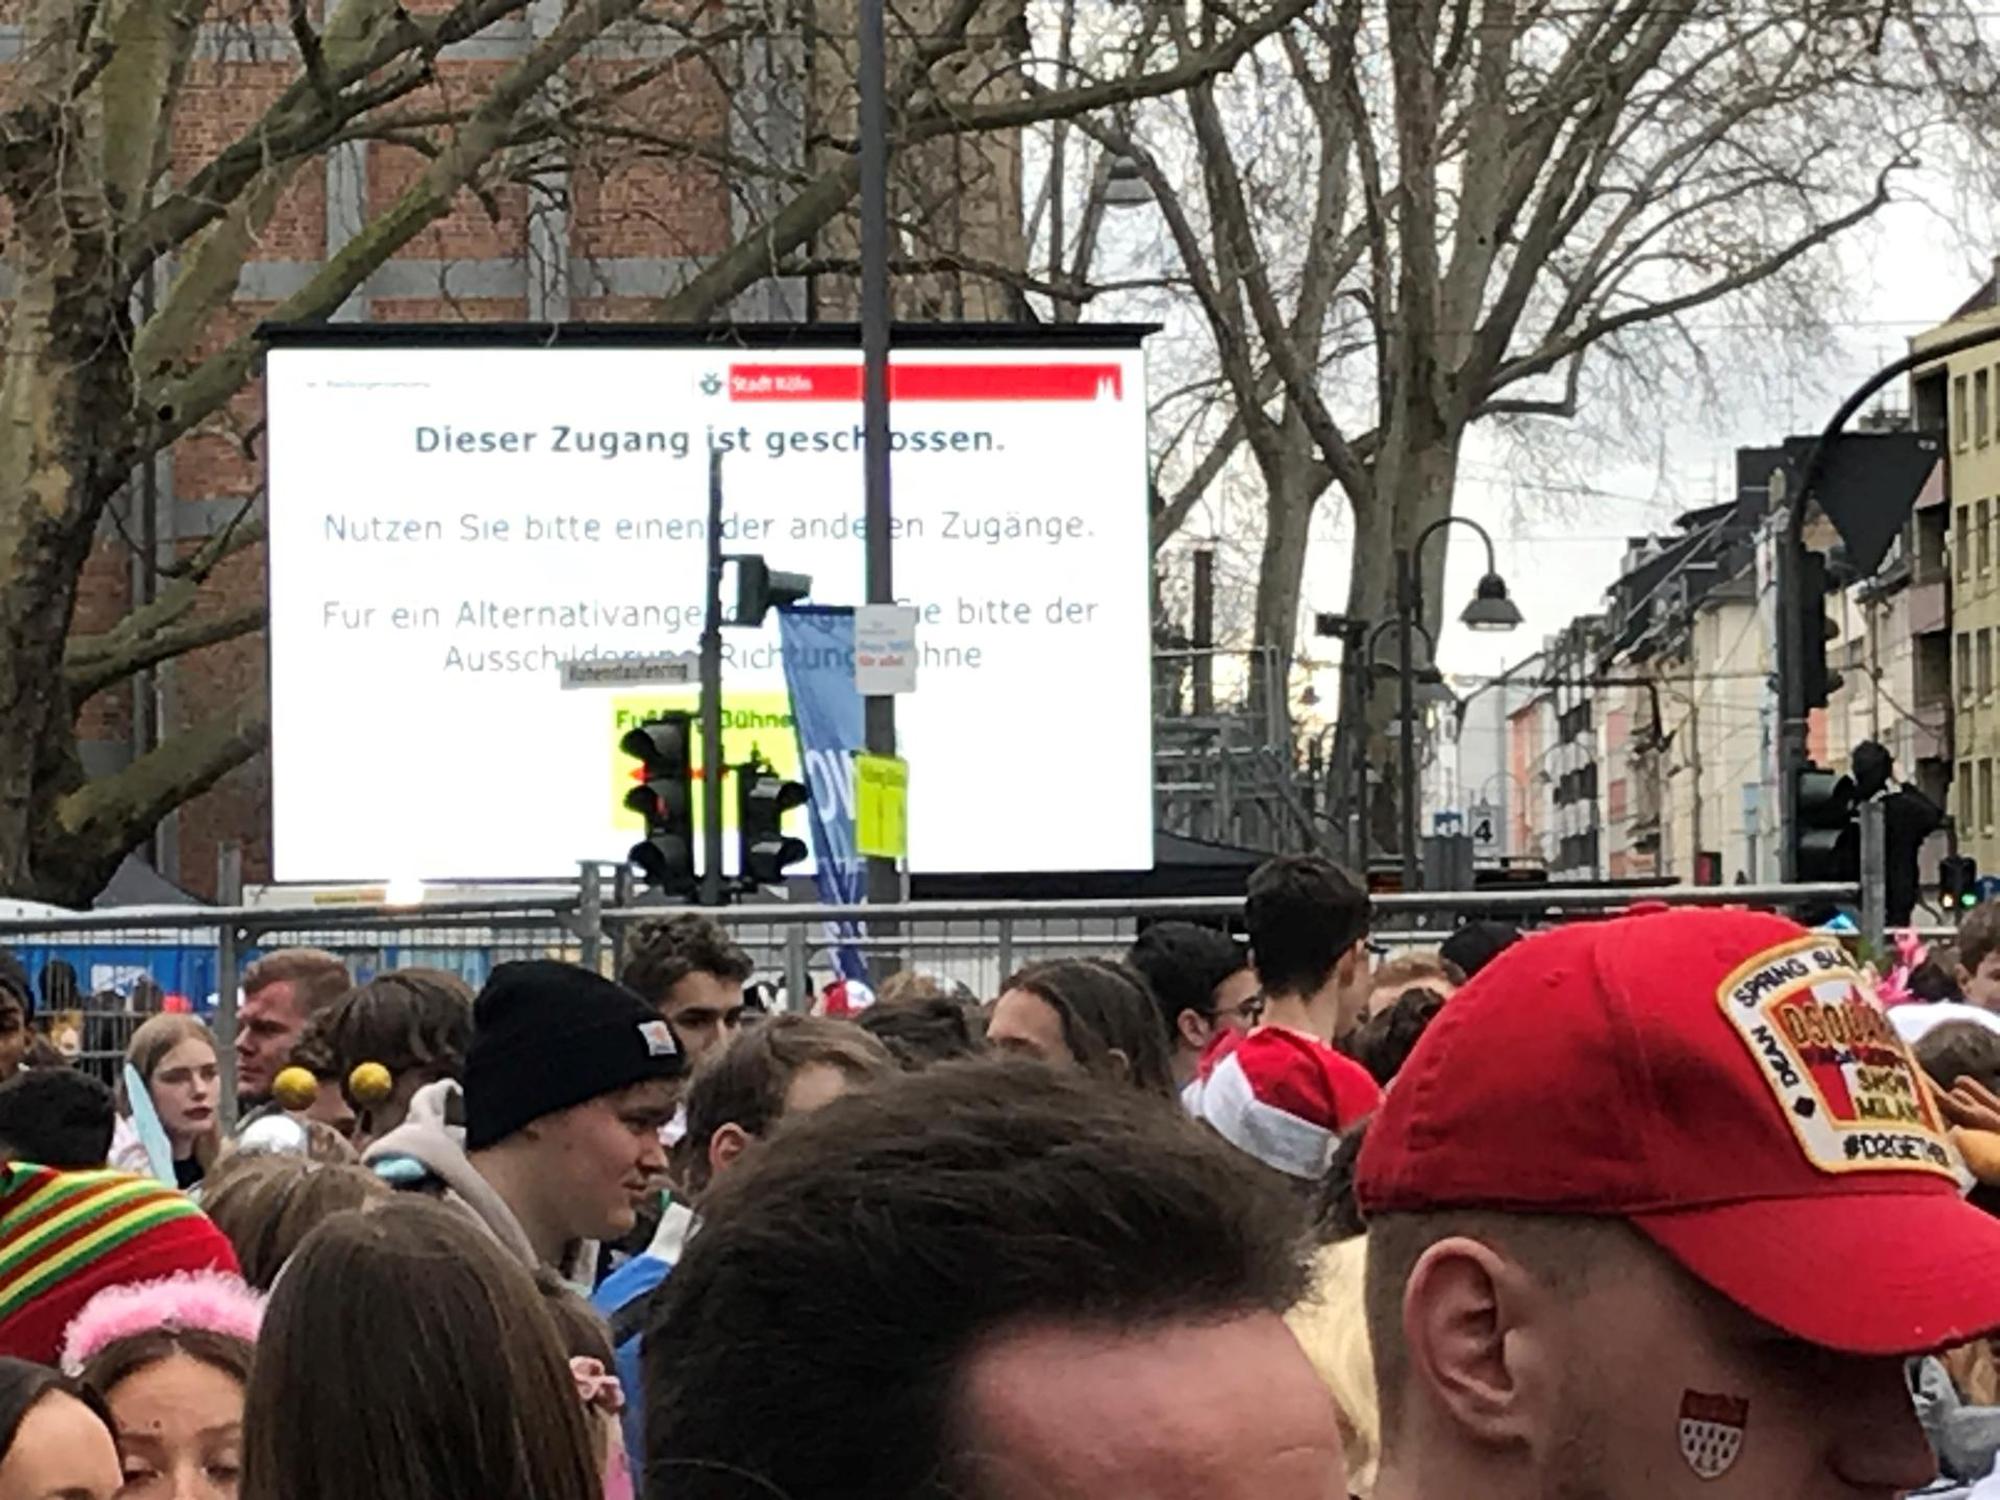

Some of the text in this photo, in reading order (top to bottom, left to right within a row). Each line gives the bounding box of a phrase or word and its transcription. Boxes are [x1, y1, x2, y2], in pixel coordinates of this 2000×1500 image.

[733, 375, 771, 392] Stadt
[416, 424, 1004, 459] Dieser Zugang ist geschossen.
[325, 510, 1094, 545] Nutzen Sie bitte einen der andeen Zugänge.
[391, 605, 439, 629] ein
[957, 597, 1033, 625] bitte
[1045, 596, 1099, 625] der
[1474, 818, 1494, 843] 4
[1733, 957, 1810, 1008] SPRING
